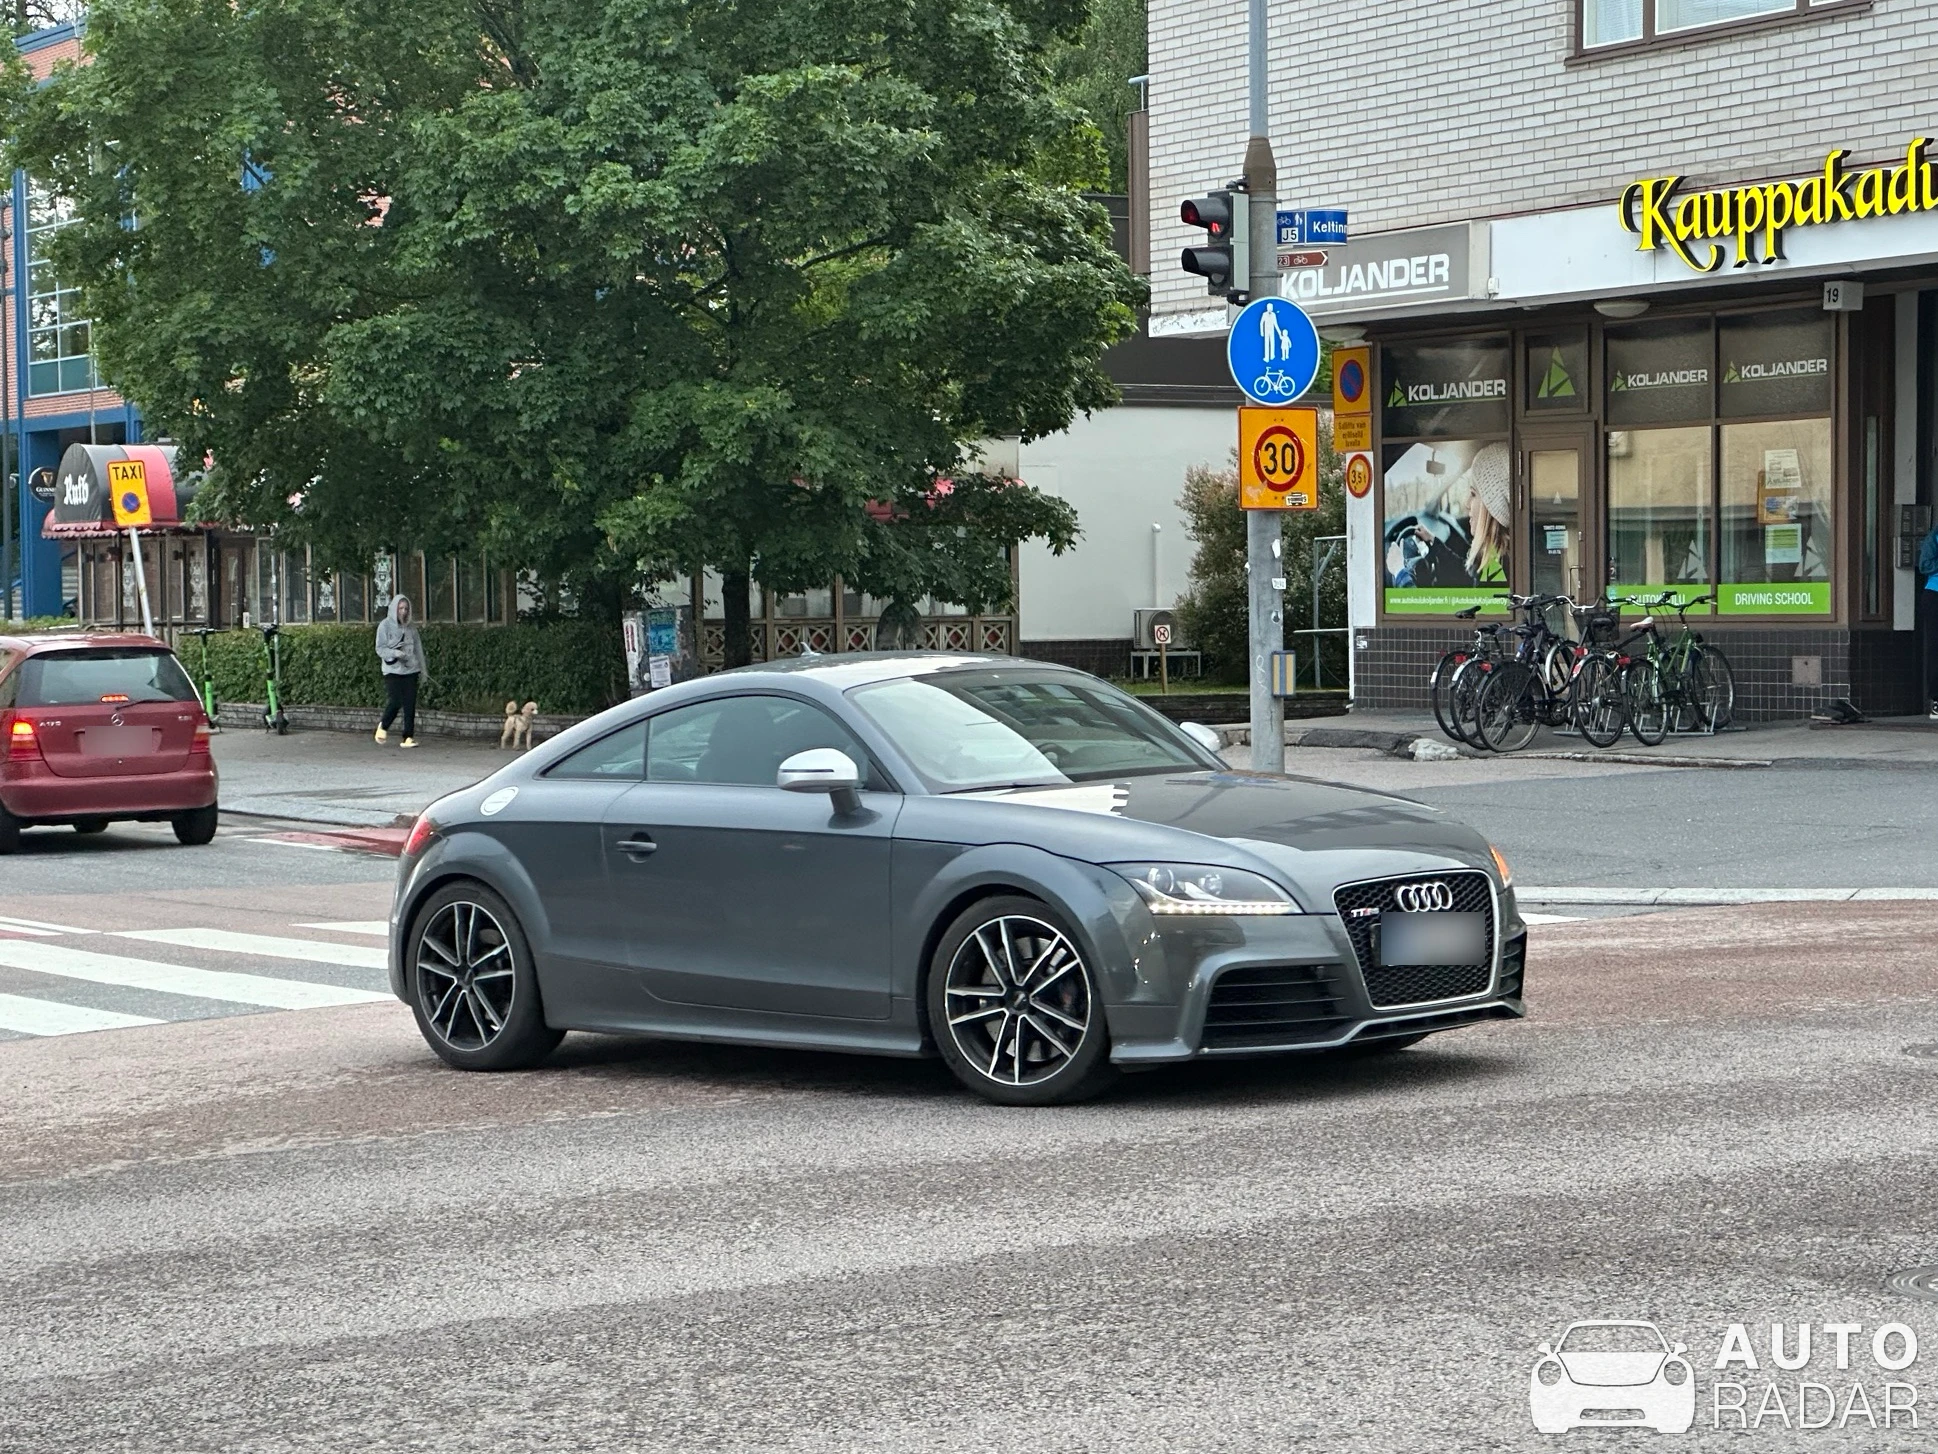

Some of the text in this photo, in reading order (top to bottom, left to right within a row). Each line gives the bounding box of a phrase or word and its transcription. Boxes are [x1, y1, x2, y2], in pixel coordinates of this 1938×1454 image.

[1280, 252, 1450, 301] KOLJANDER
[1826, 287, 1839, 303] 19
[1627, 368, 1708, 389] KOLJANDER
[1740, 358, 1828, 380] KOLJANDER
[1408, 378, 1506, 402] KOLJANDER
[1263, 442, 1296, 475] 30
[112, 465, 143, 480] TAXI
[1735, 592, 1814, 606] DRIVING SCHOOL
